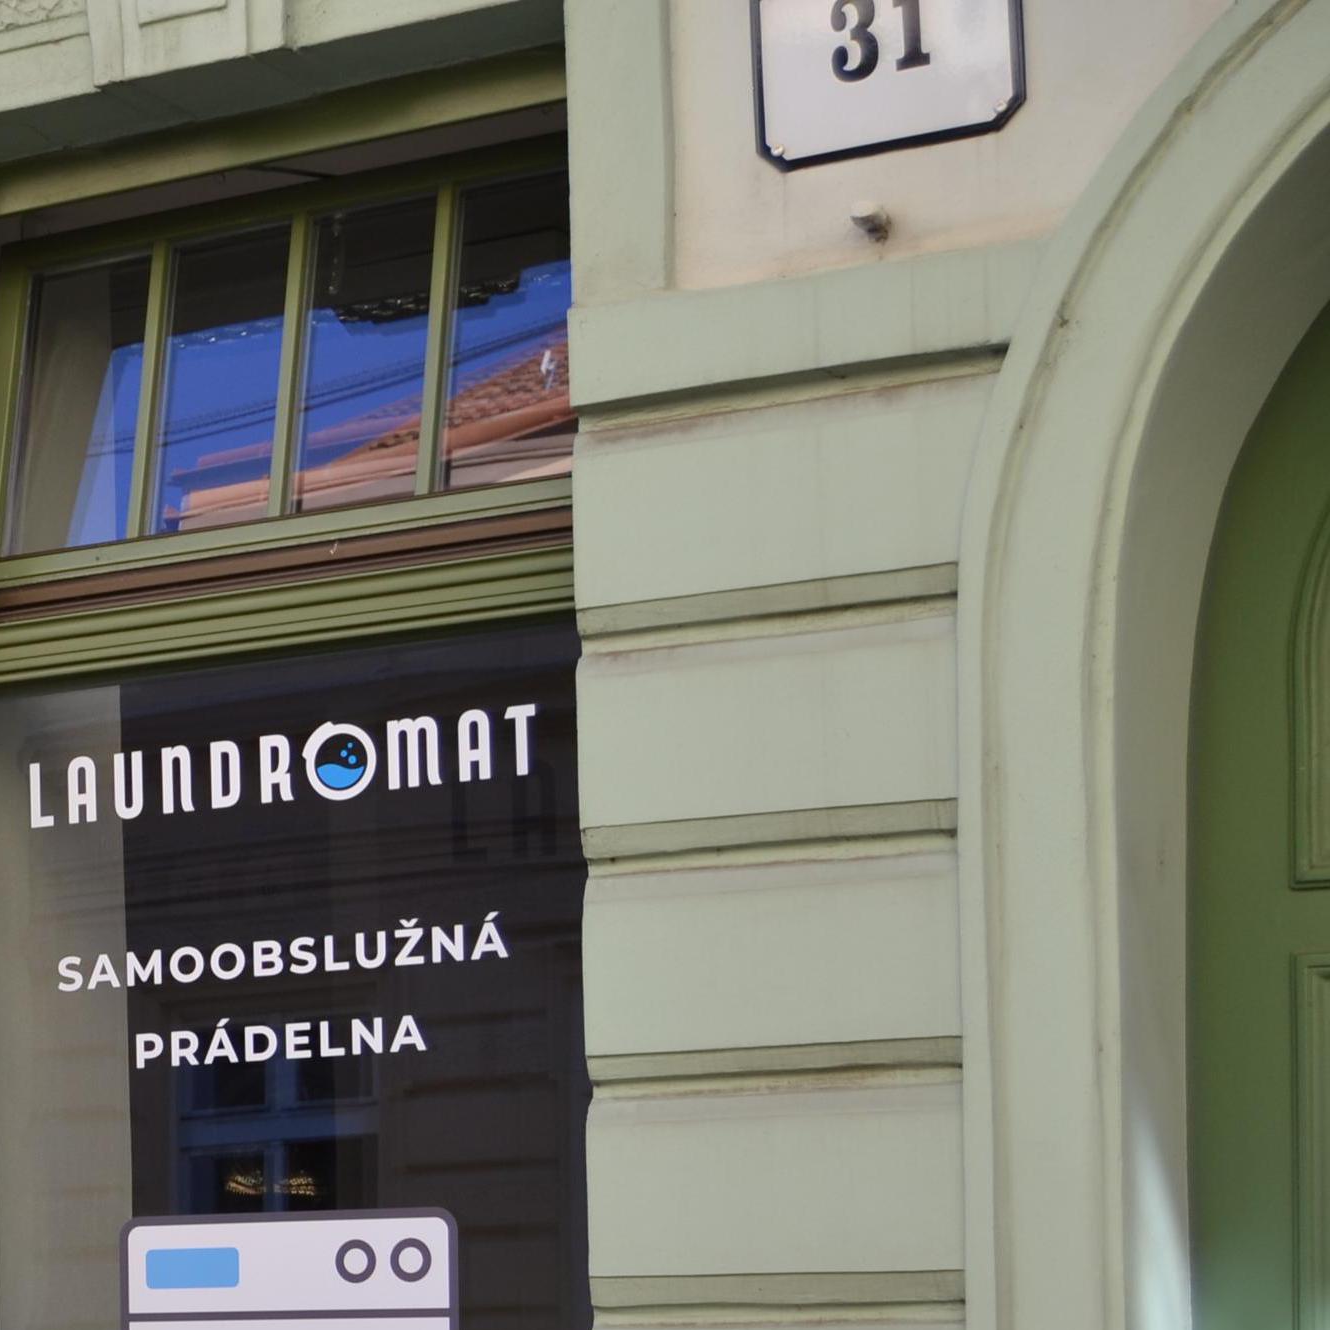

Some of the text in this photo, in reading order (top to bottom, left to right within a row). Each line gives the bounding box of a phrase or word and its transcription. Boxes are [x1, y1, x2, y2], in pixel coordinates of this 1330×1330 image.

[830, 0, 930, 83] 31
[29, 703, 537, 829] LAUNDROMAT
[57, 911, 509, 993] SAMOOBSLUŽNÁ
[136, 1014, 427, 1069] PRÁDELNA
